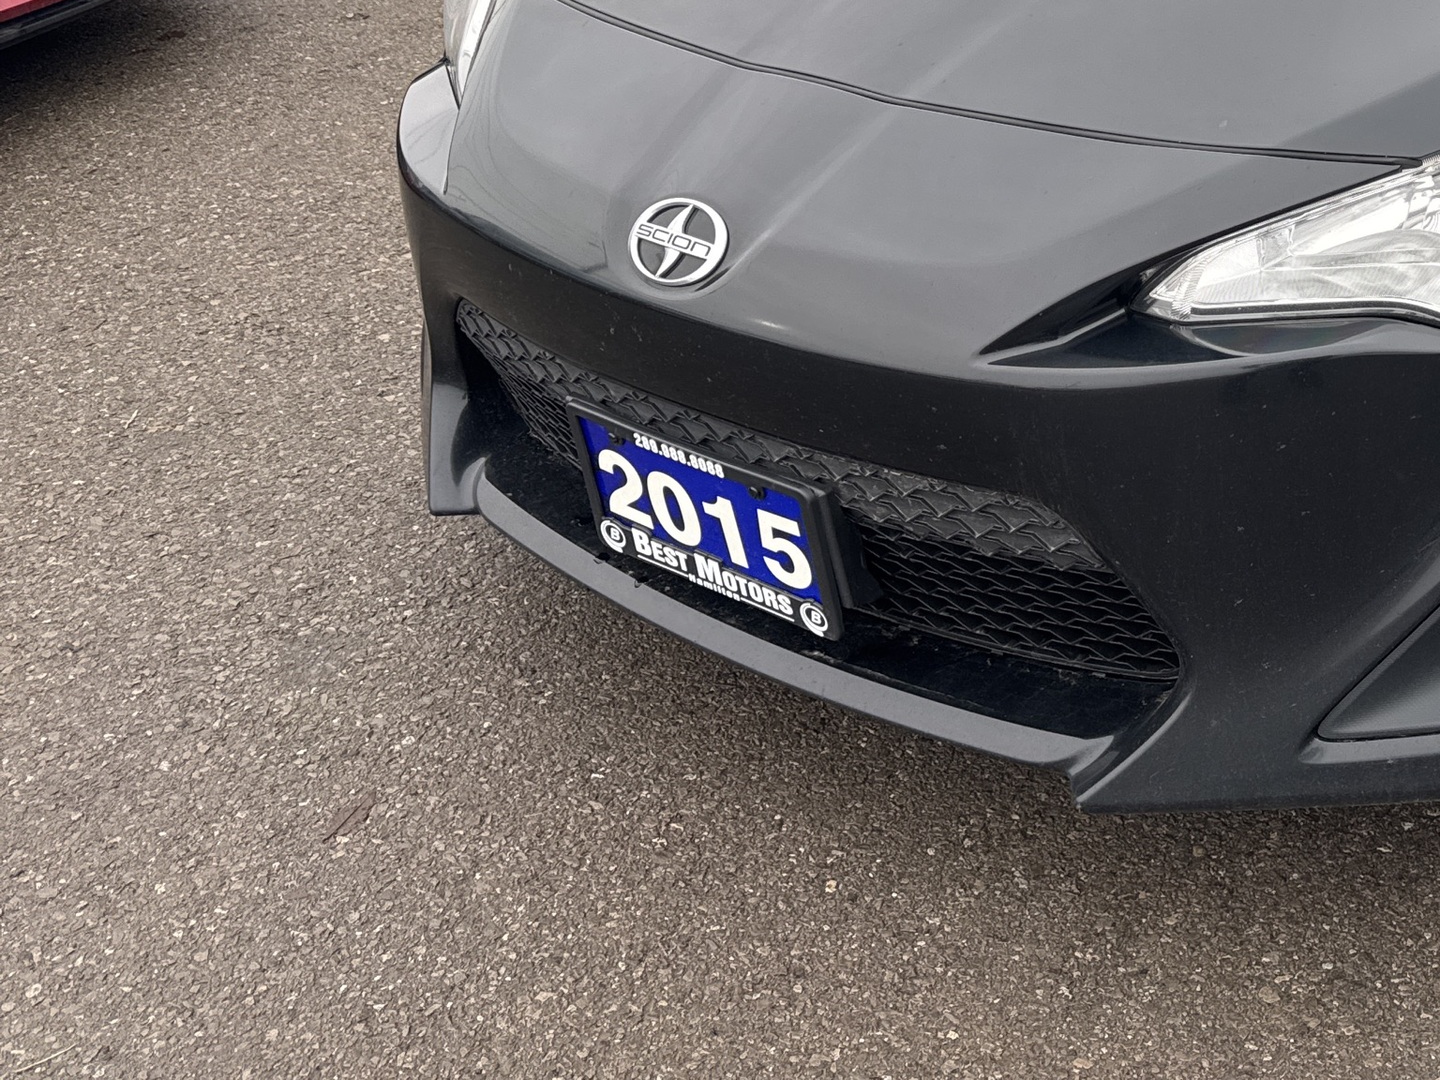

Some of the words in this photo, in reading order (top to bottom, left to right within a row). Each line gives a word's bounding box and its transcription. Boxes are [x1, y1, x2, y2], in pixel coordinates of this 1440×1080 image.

[636, 223, 712, 257] SCION
[597, 448, 813, 590] 2015
[632, 527, 687, 571] BEST
[694, 553, 794, 615] MOTORS
[688, 573, 741, 602] Hamilton
